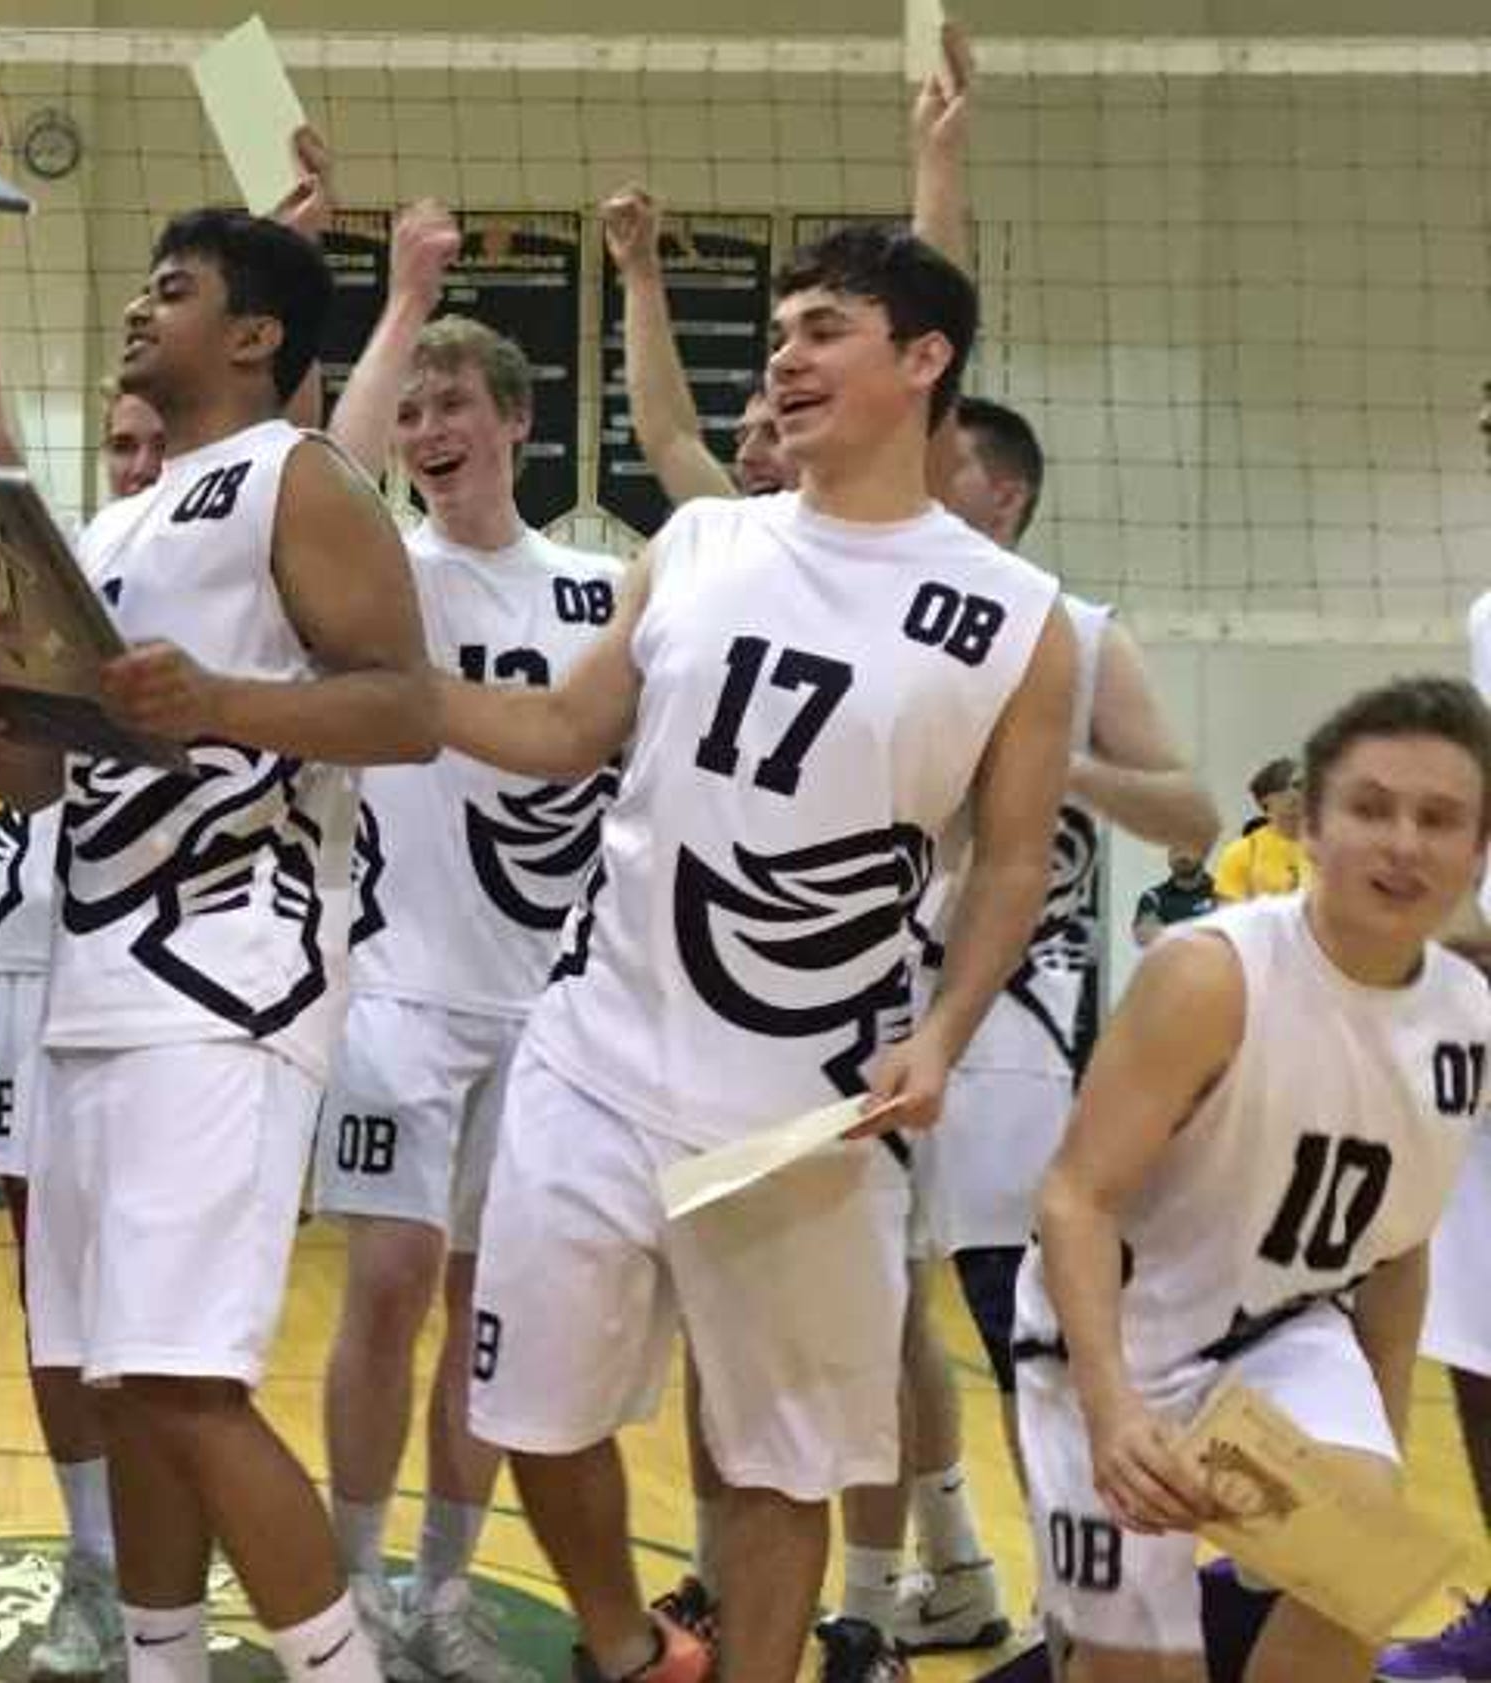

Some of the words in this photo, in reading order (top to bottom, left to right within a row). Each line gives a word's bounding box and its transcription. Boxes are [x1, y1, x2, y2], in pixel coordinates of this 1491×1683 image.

[171, 460, 253, 523] OB
[553, 577, 613, 625] OB
[903, 580, 1006, 667] OB
[695, 636, 853, 796] 17
[337, 1114, 398, 1174] OB
[1258, 1133, 1392, 1269] 10
[1050, 1510, 1122, 1592] OB
